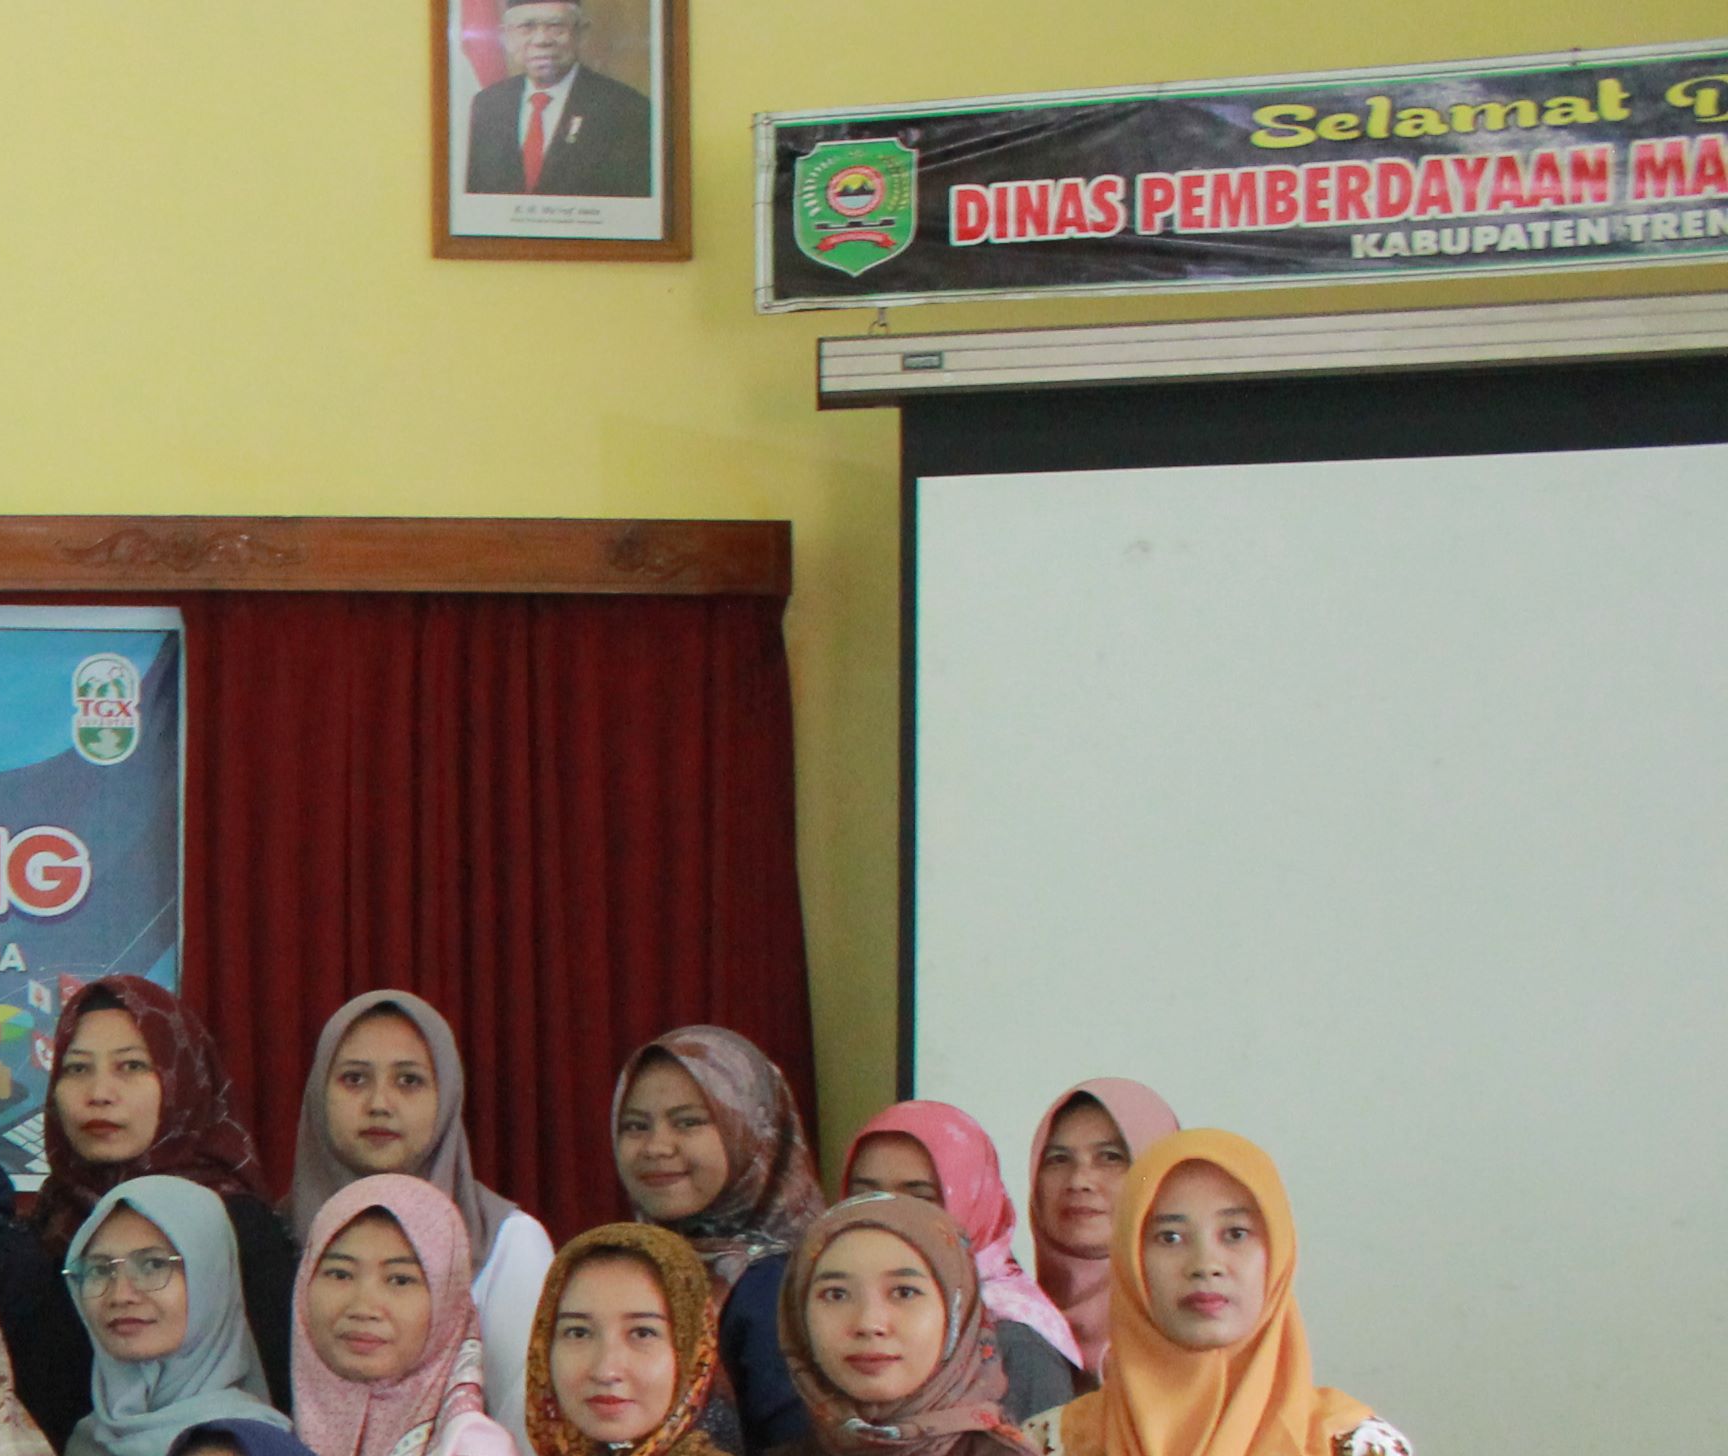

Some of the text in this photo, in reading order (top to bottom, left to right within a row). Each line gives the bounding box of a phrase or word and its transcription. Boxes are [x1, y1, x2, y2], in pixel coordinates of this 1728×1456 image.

[1251, 78, 1631, 146] Selamat
[952, 178, 1124, 246] DINAS
[1138, 146, 1612, 234] PEMBERDAYAAN
[1352, 216, 1611, 260] KABUPATEN
[78, 699, 133, 717] TGX
